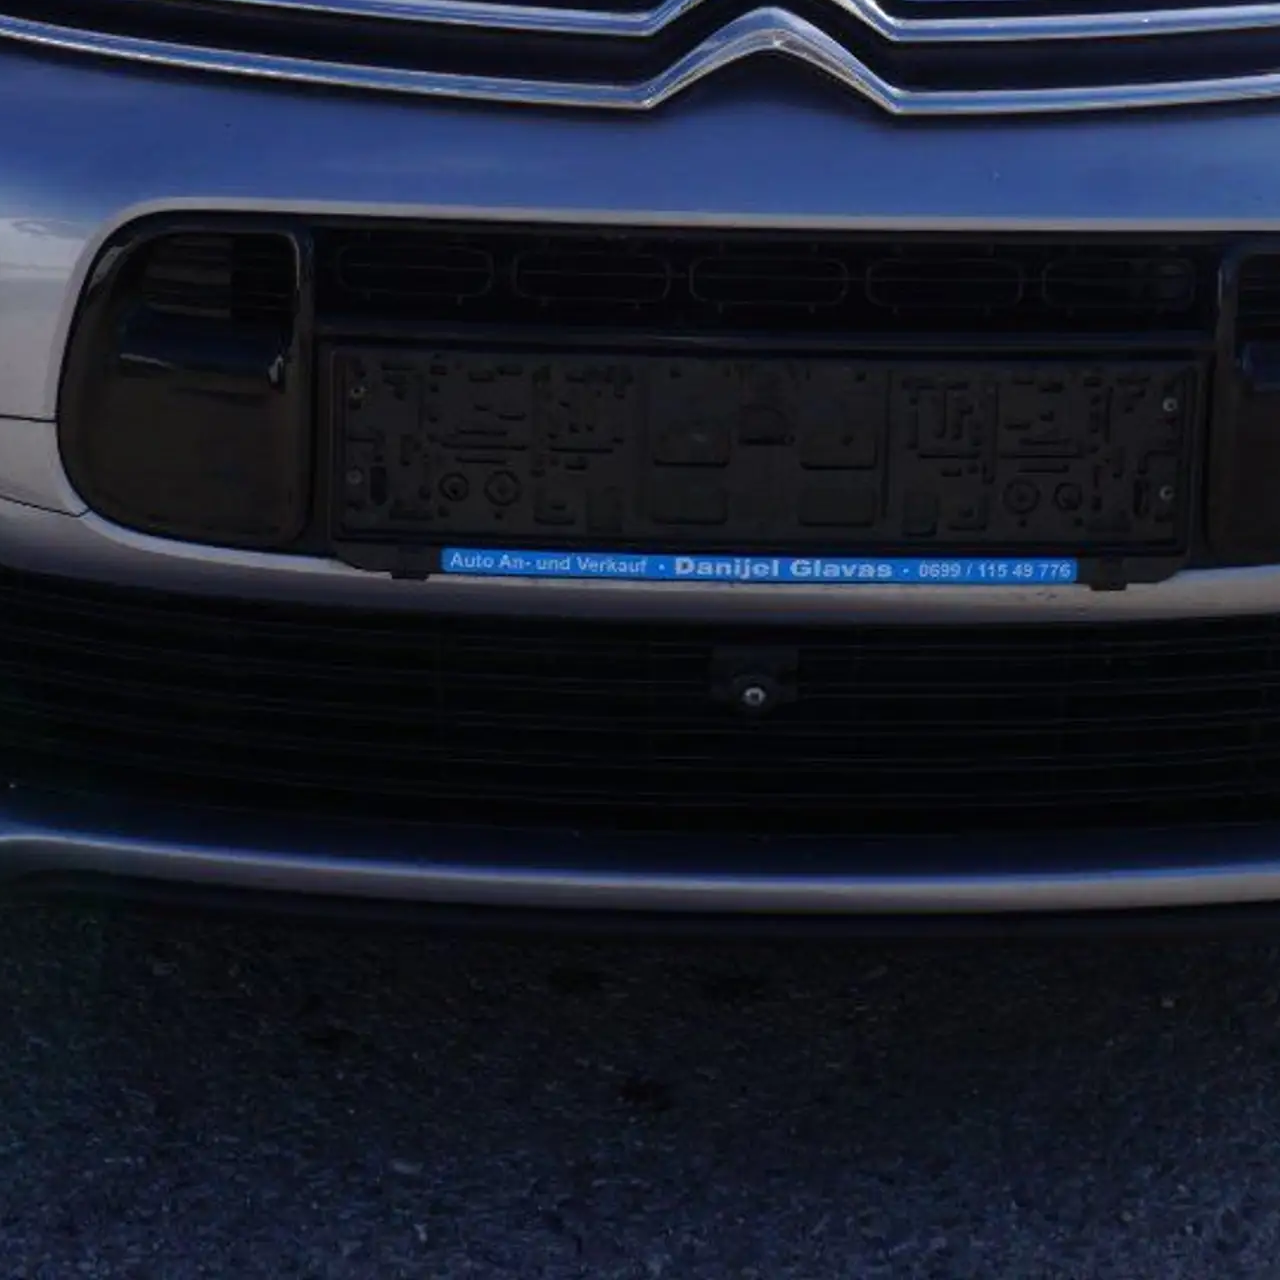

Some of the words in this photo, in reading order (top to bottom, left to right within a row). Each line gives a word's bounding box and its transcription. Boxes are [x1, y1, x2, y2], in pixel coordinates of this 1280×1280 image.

[449, 551, 493, 570] Auto
[498, 553, 530, 570] An-
[536, 554, 570, 571] und
[575, 555, 646, 574] Verkauf
[674, 556, 780, 580] Danijel
[789, 559, 893, 578] Glavas
